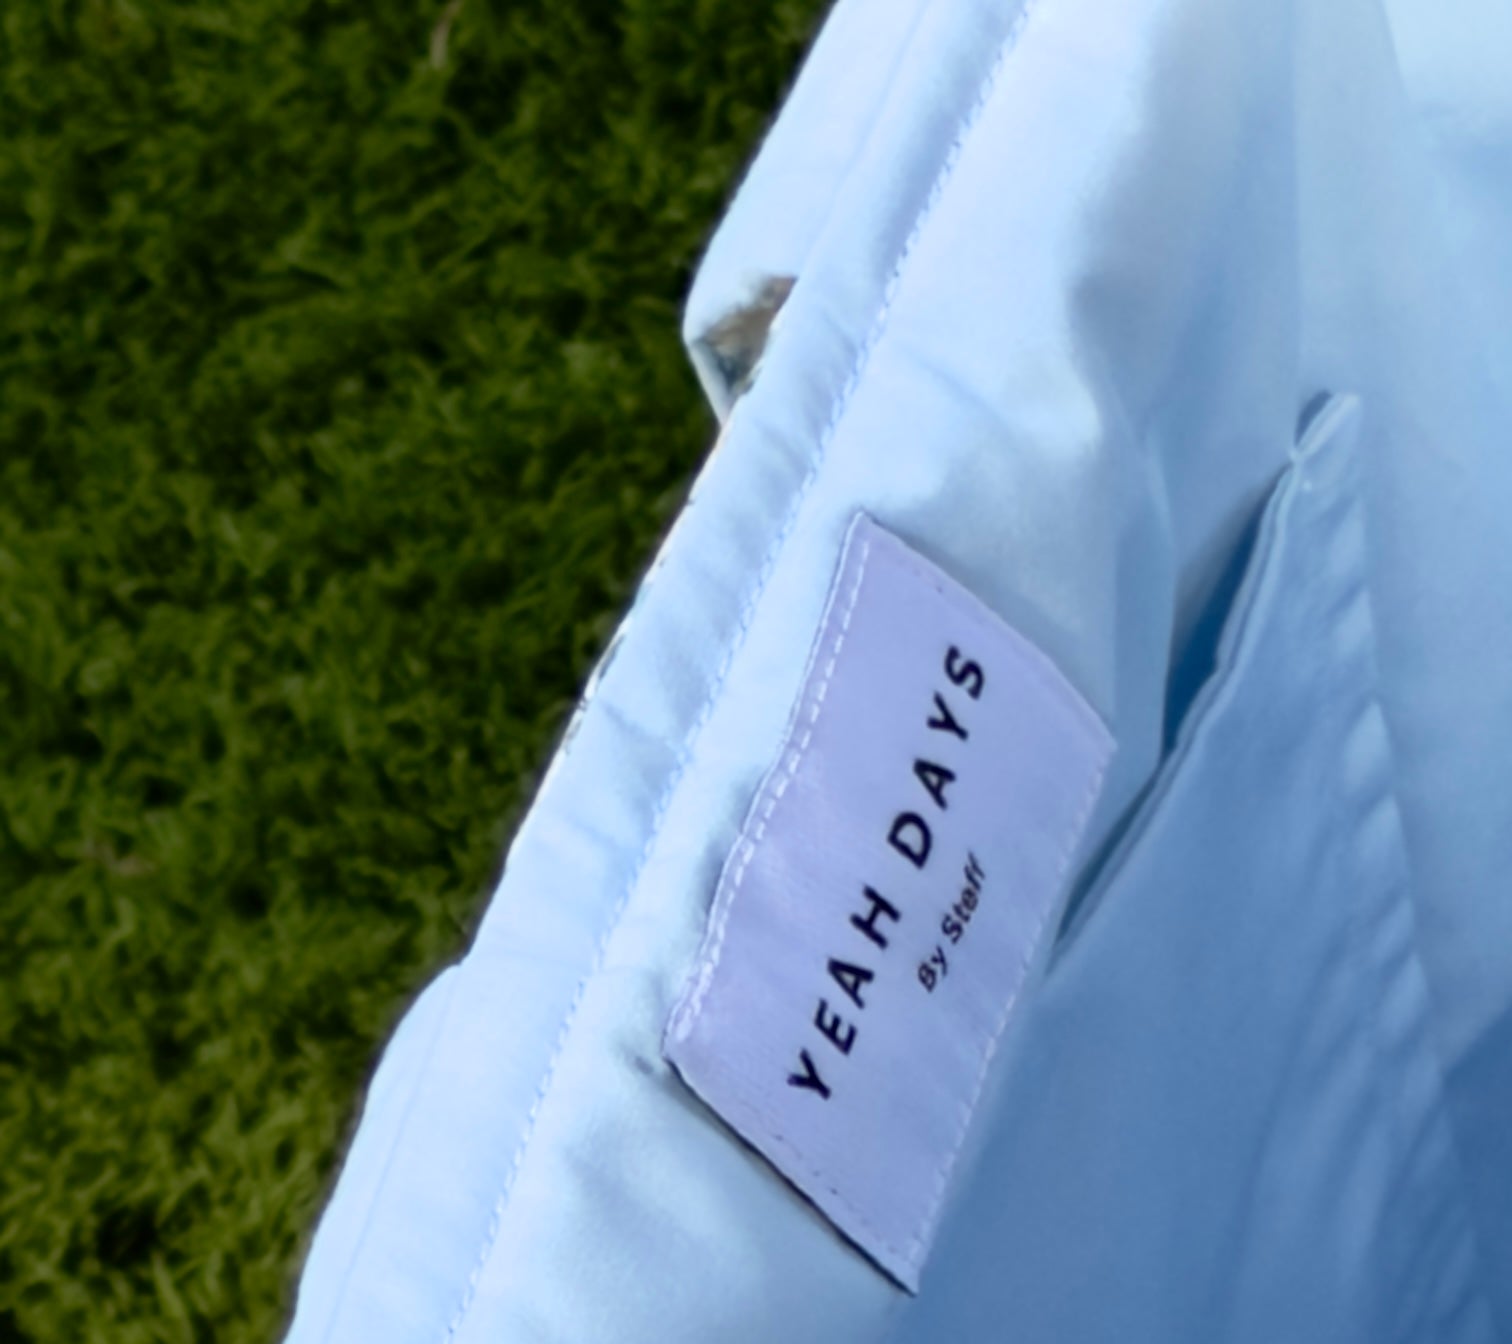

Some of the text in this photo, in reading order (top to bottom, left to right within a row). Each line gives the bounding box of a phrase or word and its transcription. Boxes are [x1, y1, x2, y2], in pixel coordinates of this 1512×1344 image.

[785, 645, 986, 1101] YEAH DAYS
[918, 944, 950, 993] By
